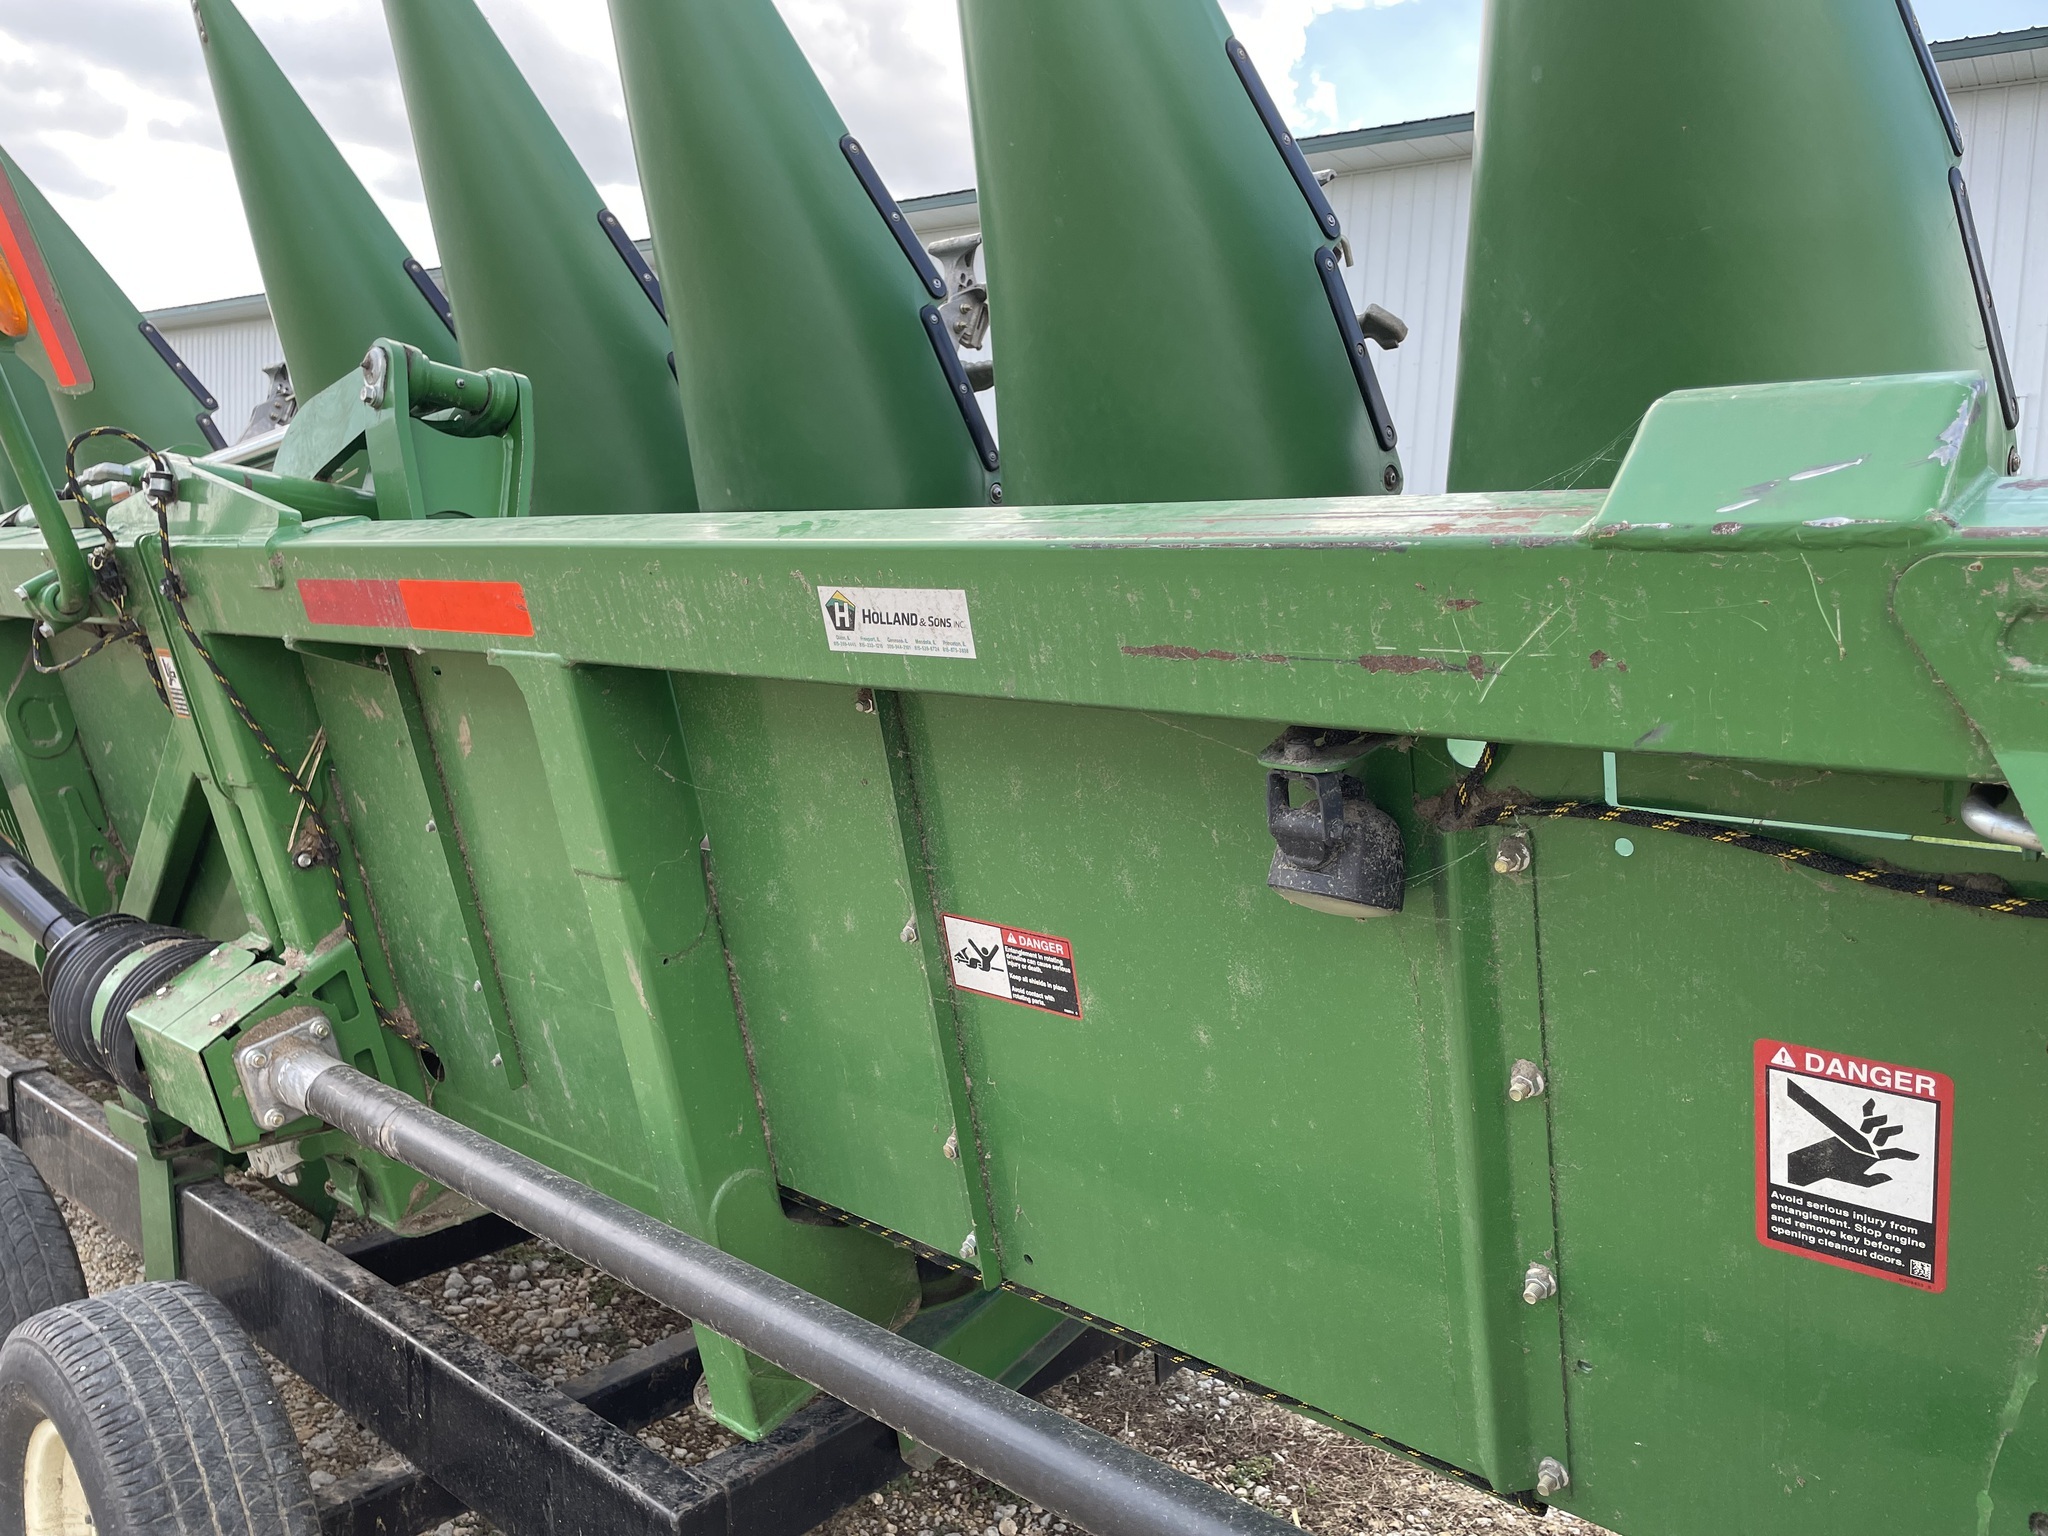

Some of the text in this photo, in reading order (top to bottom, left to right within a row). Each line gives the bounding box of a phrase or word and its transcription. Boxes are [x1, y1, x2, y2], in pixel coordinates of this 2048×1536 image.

[862, 609, 918, 626] HOLLAND
[919, 618, 926, 626] &
[928, 616, 952, 628] SONS
[1019, 935, 1064, 955] DANGER
[1009, 972, 1021, 982] Keep
[1052, 964, 1071, 974] serious
[1012, 986, 1055, 1002] Avoid contact with
[1805, 1052, 1936, 1097] DANGER
[1770, 1190, 1918, 1235] Avoid serious injury from
[1770, 1203, 1926, 1249] entanglement. Stop engine
[1770, 1213, 1902, 1254] and remove key before
[1770, 1225, 1905, 1267] opening cleanout doors.
